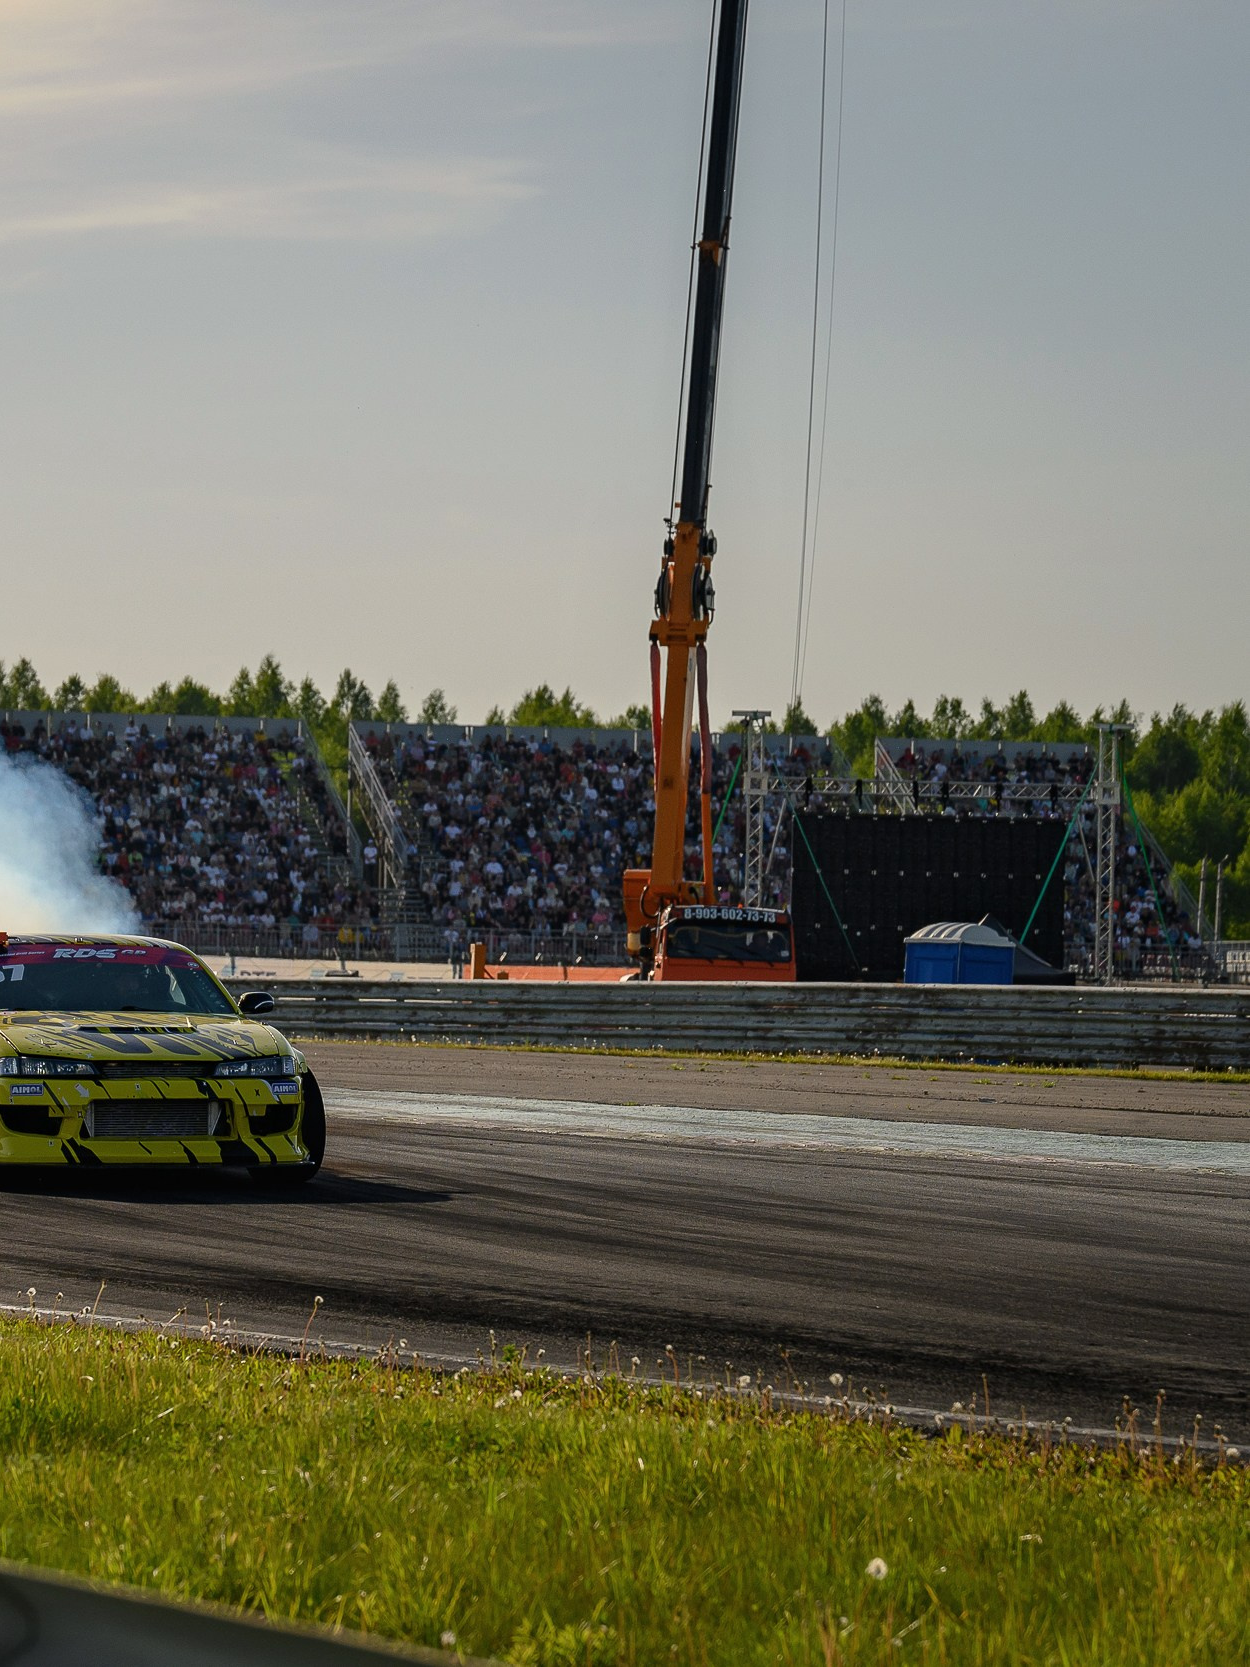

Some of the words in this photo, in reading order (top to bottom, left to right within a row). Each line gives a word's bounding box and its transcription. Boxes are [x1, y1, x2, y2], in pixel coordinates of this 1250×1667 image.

[684, 907, 776, 923] 8-903-602-73-73
[53, 948, 119, 959] RDS
[12, 1086, 42, 1094] AIMOL
[274, 1085, 296, 1093] AIMOL
